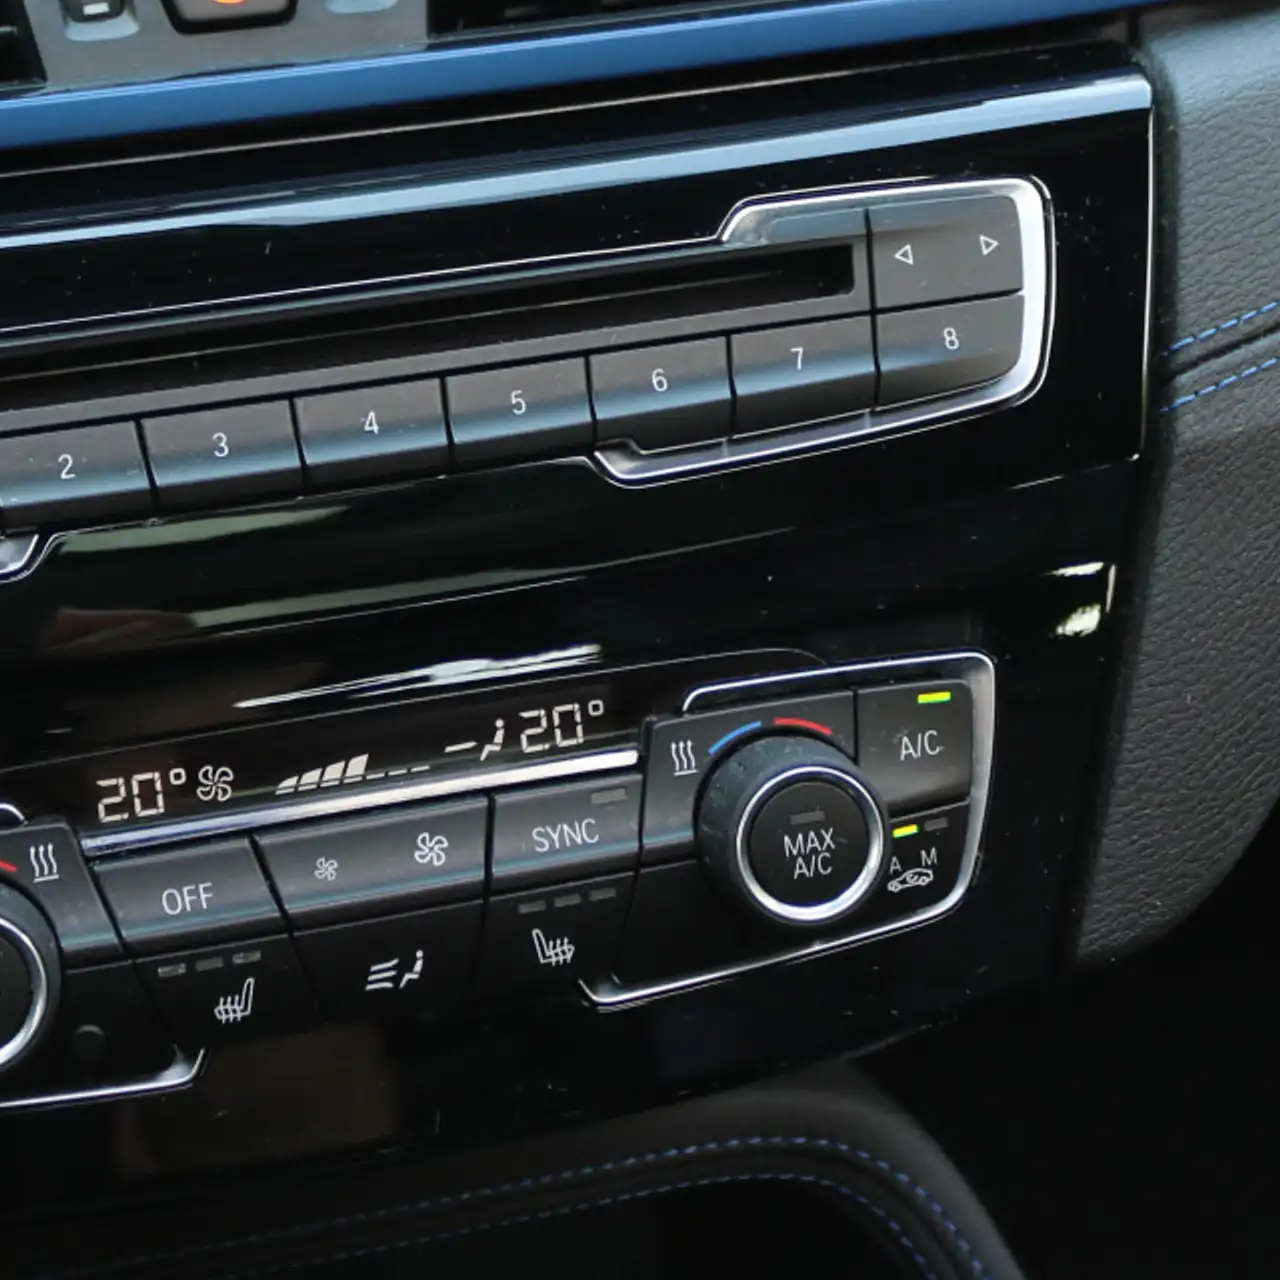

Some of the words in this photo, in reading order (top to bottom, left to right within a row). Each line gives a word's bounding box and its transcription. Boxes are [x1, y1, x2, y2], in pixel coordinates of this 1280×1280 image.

[942, 327, 960, 350] 8
[789, 347, 805, 370] 7
[651, 368, 669, 393] 6
[510, 390, 527, 415] 5
[362, 411, 380, 436] 4
[212, 433, 229, 458] 3
[57, 453, 76, 480] 2
[899, 729, 943, 761] A/C
[531, 818, 600, 853] SYNC
[783, 828, 836, 858] MAX
[792, 852, 833, 879] A/C
[888, 856, 902, 874] A
[921, 848, 938, 866] M
[161, 882, 213, 916] OFF
